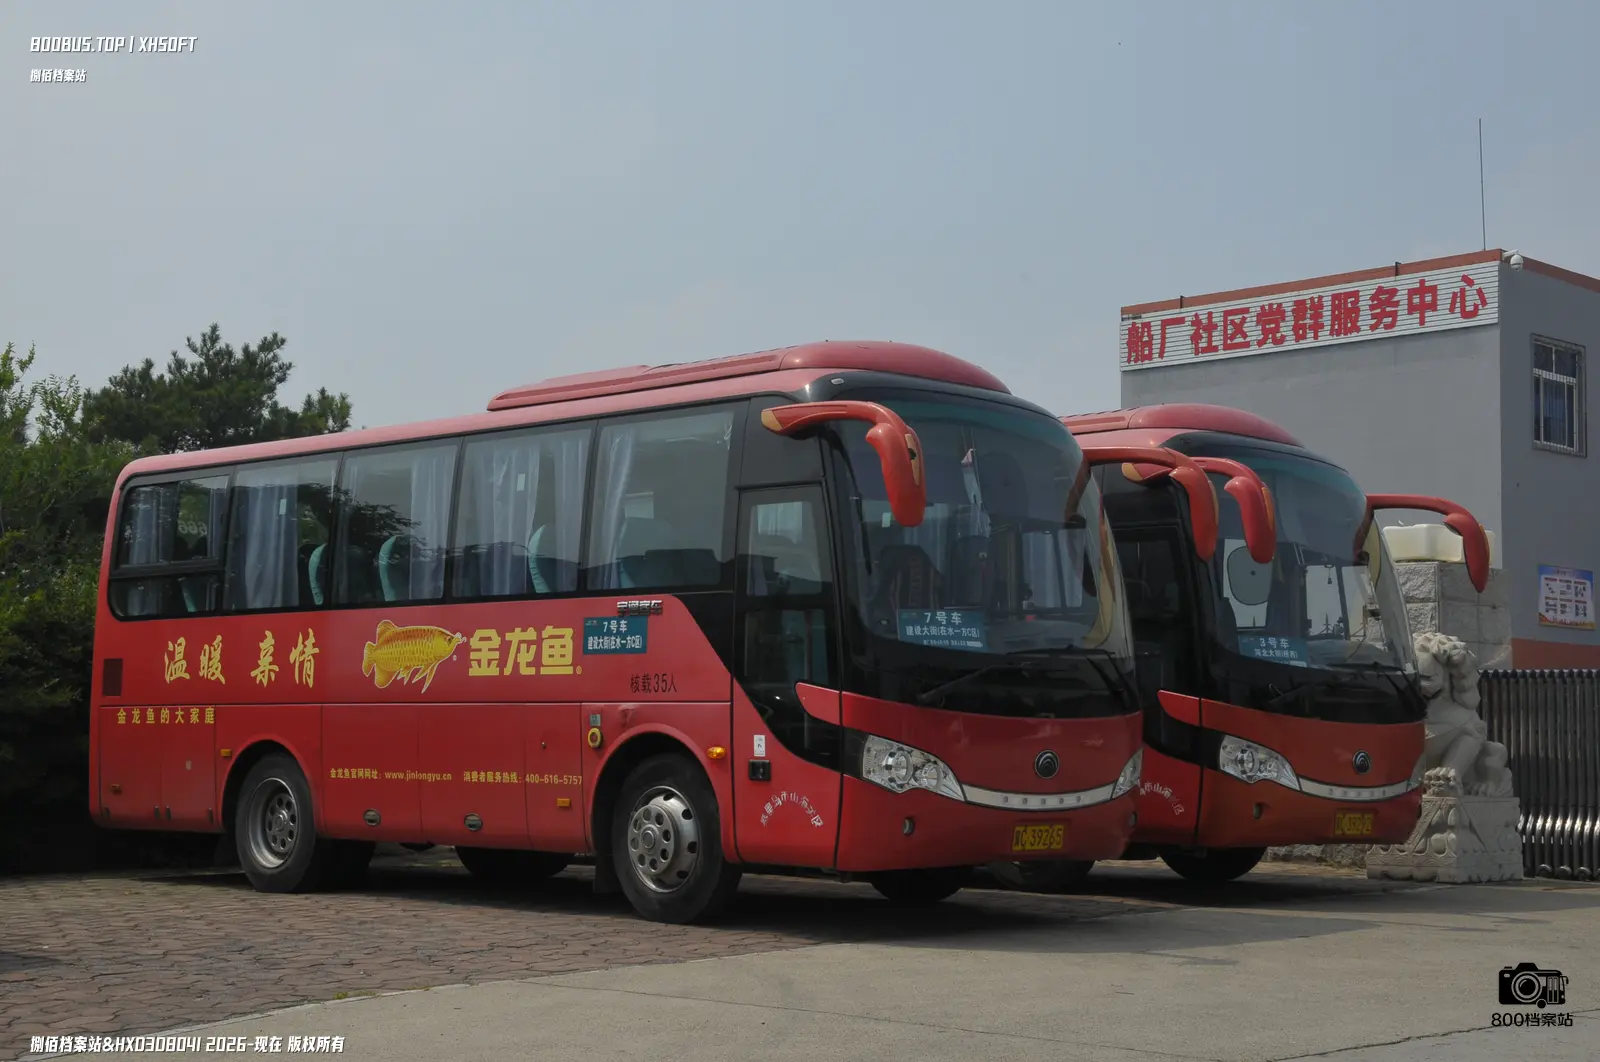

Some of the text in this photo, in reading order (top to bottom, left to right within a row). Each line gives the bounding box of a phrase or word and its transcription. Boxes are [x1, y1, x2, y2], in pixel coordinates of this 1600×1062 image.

[1126, 274, 1488, 364] 船厂社区党群服务中心
[603, 619, 628, 633] 7号车
[924, 611, 962, 625] 7号车
[468, 625, 574, 676] 金龙鱼
[1260, 637, 1290, 649] 3号车
[164, 634, 226, 684] 温暖
[630, 673, 677, 693] 核载35人
[117, 706, 215, 724] 金龙鱼的大家庭
[384, 769, 452, 781] www.jinlongyu.cn
[525, 774, 582, 785] 400-616-5757
